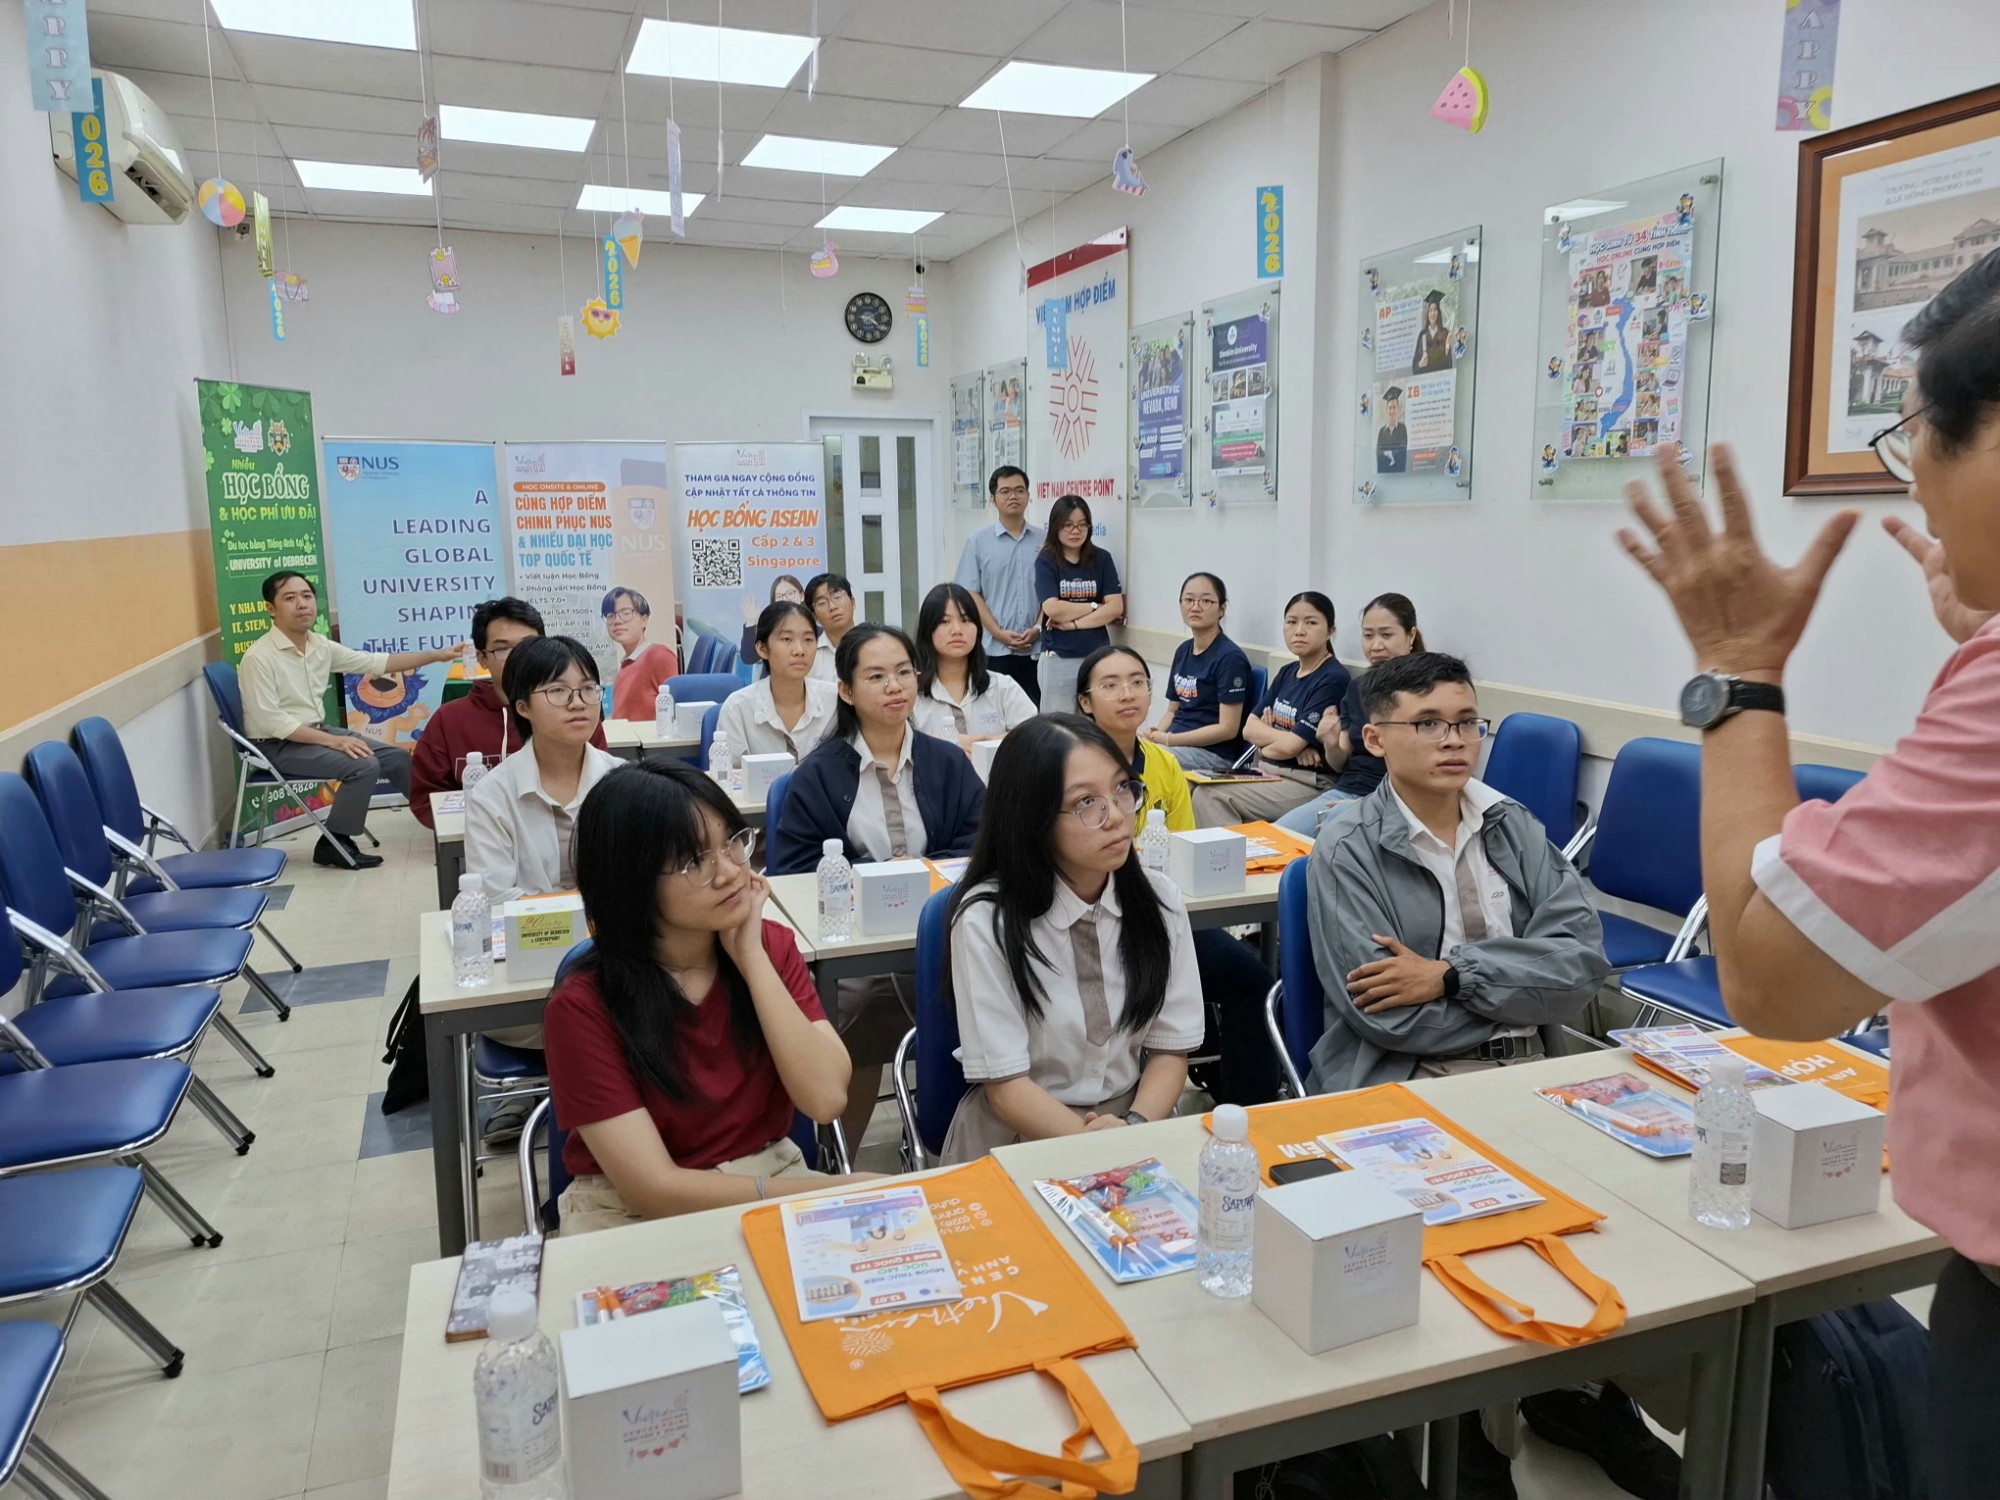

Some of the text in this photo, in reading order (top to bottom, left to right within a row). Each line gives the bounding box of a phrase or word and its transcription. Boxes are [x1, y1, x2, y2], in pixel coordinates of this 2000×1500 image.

[41, 0, 72, 100] PPY
[1792, 8, 1825, 120] APPY
[81, 114, 109, 196] 026
[1261, 192, 1281, 273] 2026
[1635, 230, 1648, 245] 34
[605, 240, 621, 306] 2026
[1074, 286, 1091, 315] HỢP
[1093, 271, 1116, 306] ĐIỂM
[1379, 305, 1392, 320] AP
[1407, 385, 1420, 399] IB
[362, 456, 399, 470] NUS
[685, 474, 712, 483] THAM
[714, 474, 730, 483] GIA
[732, 474, 757, 483] NGAY
[759, 472, 786, 485] CỘNG
[223, 472, 260, 505] HỌC
[475, 490, 488, 504] A
[685, 487, 703, 499] CẬP
[705, 487, 730, 499] NHẬT
[732, 486, 750, 497] TẤT
[767, 487, 799, 497] THÔNG
[801, 489, 816, 497] TIN
[1036, 482, 1050, 499] VIET
[1093, 479, 1115, 496] POINT
[515, 494, 546, 511] CÙNG
[550, 496, 573, 513] HỢP
[219, 507, 228, 521] &
[231, 506, 257, 523] HỌC
[260, 503, 278, 520] PHÍ
[687, 500, 819, 532] HỌC BỔNG ASEAN
[393, 518, 491, 534] LEADING
[516, 515, 612, 532] CHINH PHỤC NUS
[518, 536, 526, 549] &
[567, 533, 586, 550] ĐẠI
[590, 533, 613, 550] HỌC
[752, 532, 815, 549] Cấp 2 & 3
[229, 555, 317, 571] UNIVERSITY of DEBRECEN
[405, 547, 494, 564] GLOBAL
[519, 549, 592, 568] TOP QUỐC TẾ
[747, 555, 820, 569] Singapore
[363, 575, 496, 594] UNIVERSITY
[398, 605, 476, 623] SHAPIN
[369, 635, 470, 652] THE FUT
[365, 726, 384, 736] NUS
